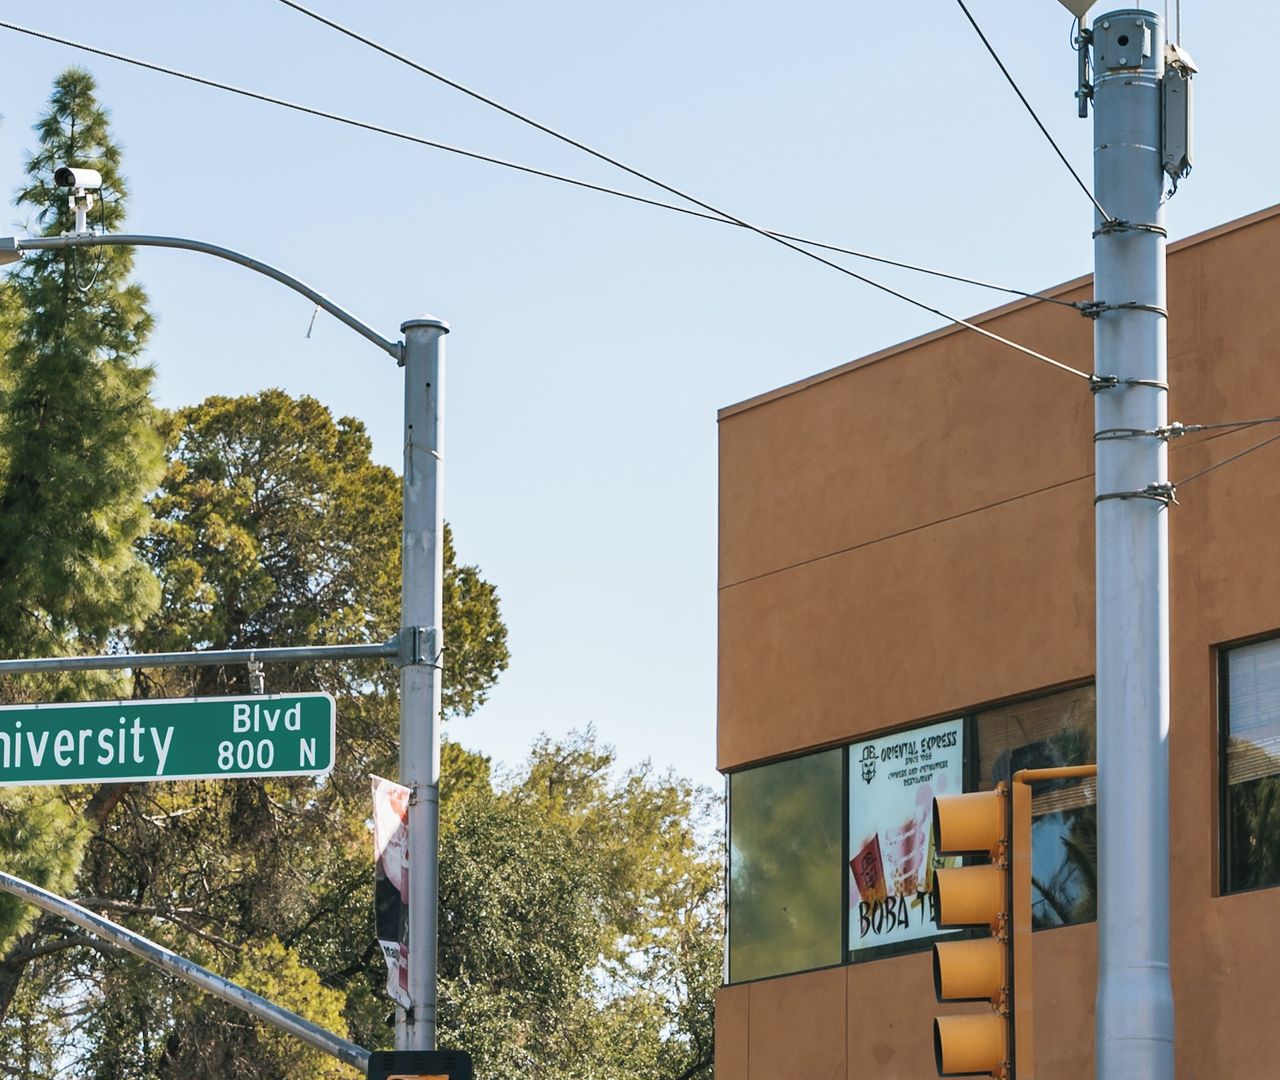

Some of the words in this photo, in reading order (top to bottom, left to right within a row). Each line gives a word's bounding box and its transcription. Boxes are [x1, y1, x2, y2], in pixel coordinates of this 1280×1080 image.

[233, 702, 301, 733] Blvd
[217, 739, 275, 770] 800
[299, 738, 317, 767] N
[880, 741, 919, 762] ORIENTAL
[920, 730, 958, 753] EXPRESS
[859, 893, 910, 938] BOBA
